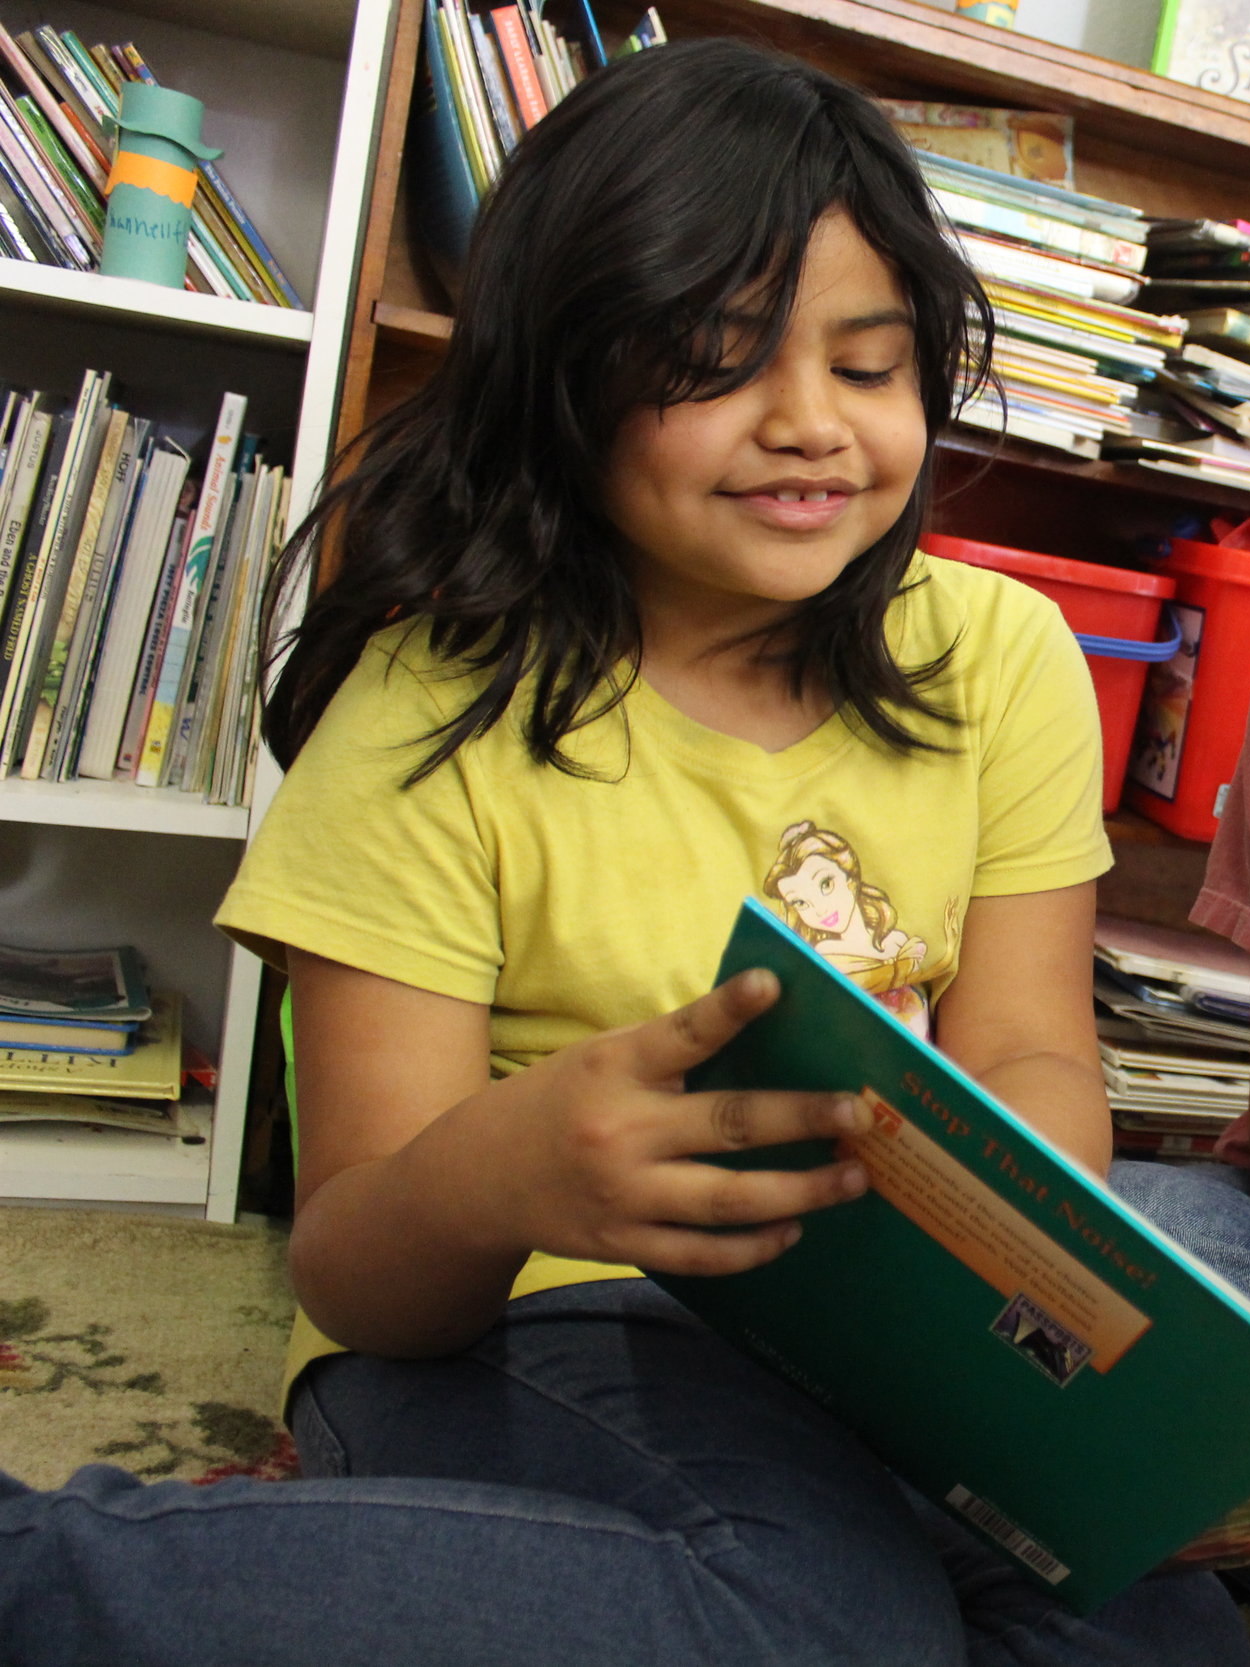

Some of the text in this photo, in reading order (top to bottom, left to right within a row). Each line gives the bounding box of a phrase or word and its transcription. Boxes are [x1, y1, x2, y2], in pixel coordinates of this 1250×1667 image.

[28, 429, 43, 470] JUSTUS
[116, 452, 132, 484] HOFF
[200, 453, 227, 532] Animal Sounds
[7, 519, 22, 546] Eben
[1, 546, 13, 567] and
[20, 560, 37, 597] GHOST
[85, 551, 105, 602] JULIUS
[11, 597, 28, 635] NAMED
[4, 633, 18, 662] FRED
[903, 1071, 1158, 1288] Stop That Noise!
[1018, 1298, 1087, 1354] PASSPORTS
